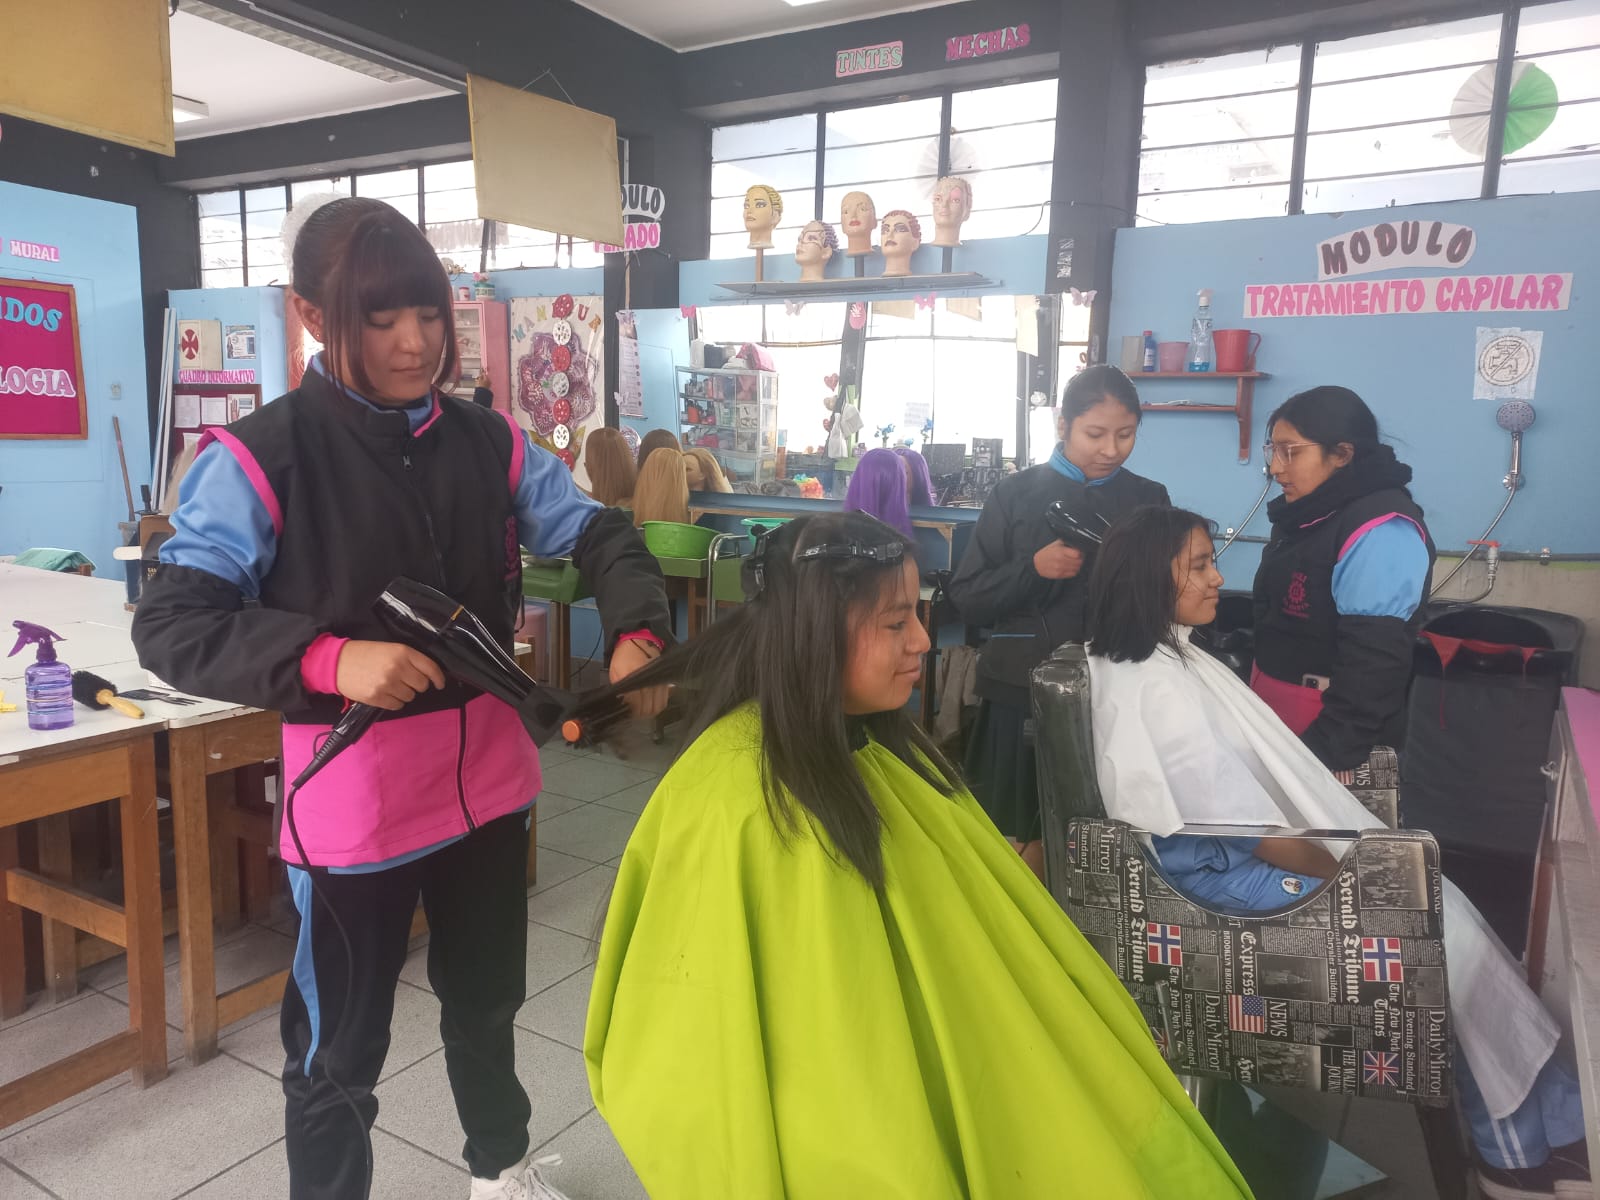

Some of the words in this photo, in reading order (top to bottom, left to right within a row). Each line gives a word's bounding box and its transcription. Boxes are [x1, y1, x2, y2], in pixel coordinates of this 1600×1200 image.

[837, 46, 902, 73] TINTES
[946, 24, 1031, 61] MECHAS
[10, 240, 60, 262] MURAL
[1321, 221, 1473, 275] MODULO
[1247, 279, 1426, 316] TRATAMIENTO
[1435, 274, 1564, 312] CAPILAR
[179, 370, 206, 383] CUADRO
[208, 369, 255, 383] INFORMATIVO
[1357, 762, 1371, 786] EWS
[1081, 824, 1090, 868] Standard
[1100, 826, 1116, 874] Mirror
[1126, 857, 1145, 913] Herald
[1338, 871, 1359, 929] Herald
[1130, 918, 1147, 983] Tribune
[1223, 930, 1232, 966] BROOKLYN
[1239, 931, 1257, 996] Express
[1326, 931, 1336, 965] Chrysler
[1224, 968, 1233, 994] BRIDGE
[1329, 968, 1338, 1003] Building
[1343, 934, 1362, 1004] Tribune
[1183, 993, 1195, 1027] Evening
[1388, 983, 1400, 1002] The
[1269, 1000, 1287, 1037] NEWS
[1374, 998, 1389, 1038] Times
[1404, 1011, 1416, 1050] Evening
[1185, 1029, 1197, 1065] Standard
[1342, 1049, 1356, 1067] THE
[1406, 1051, 1416, 1090] Standard
